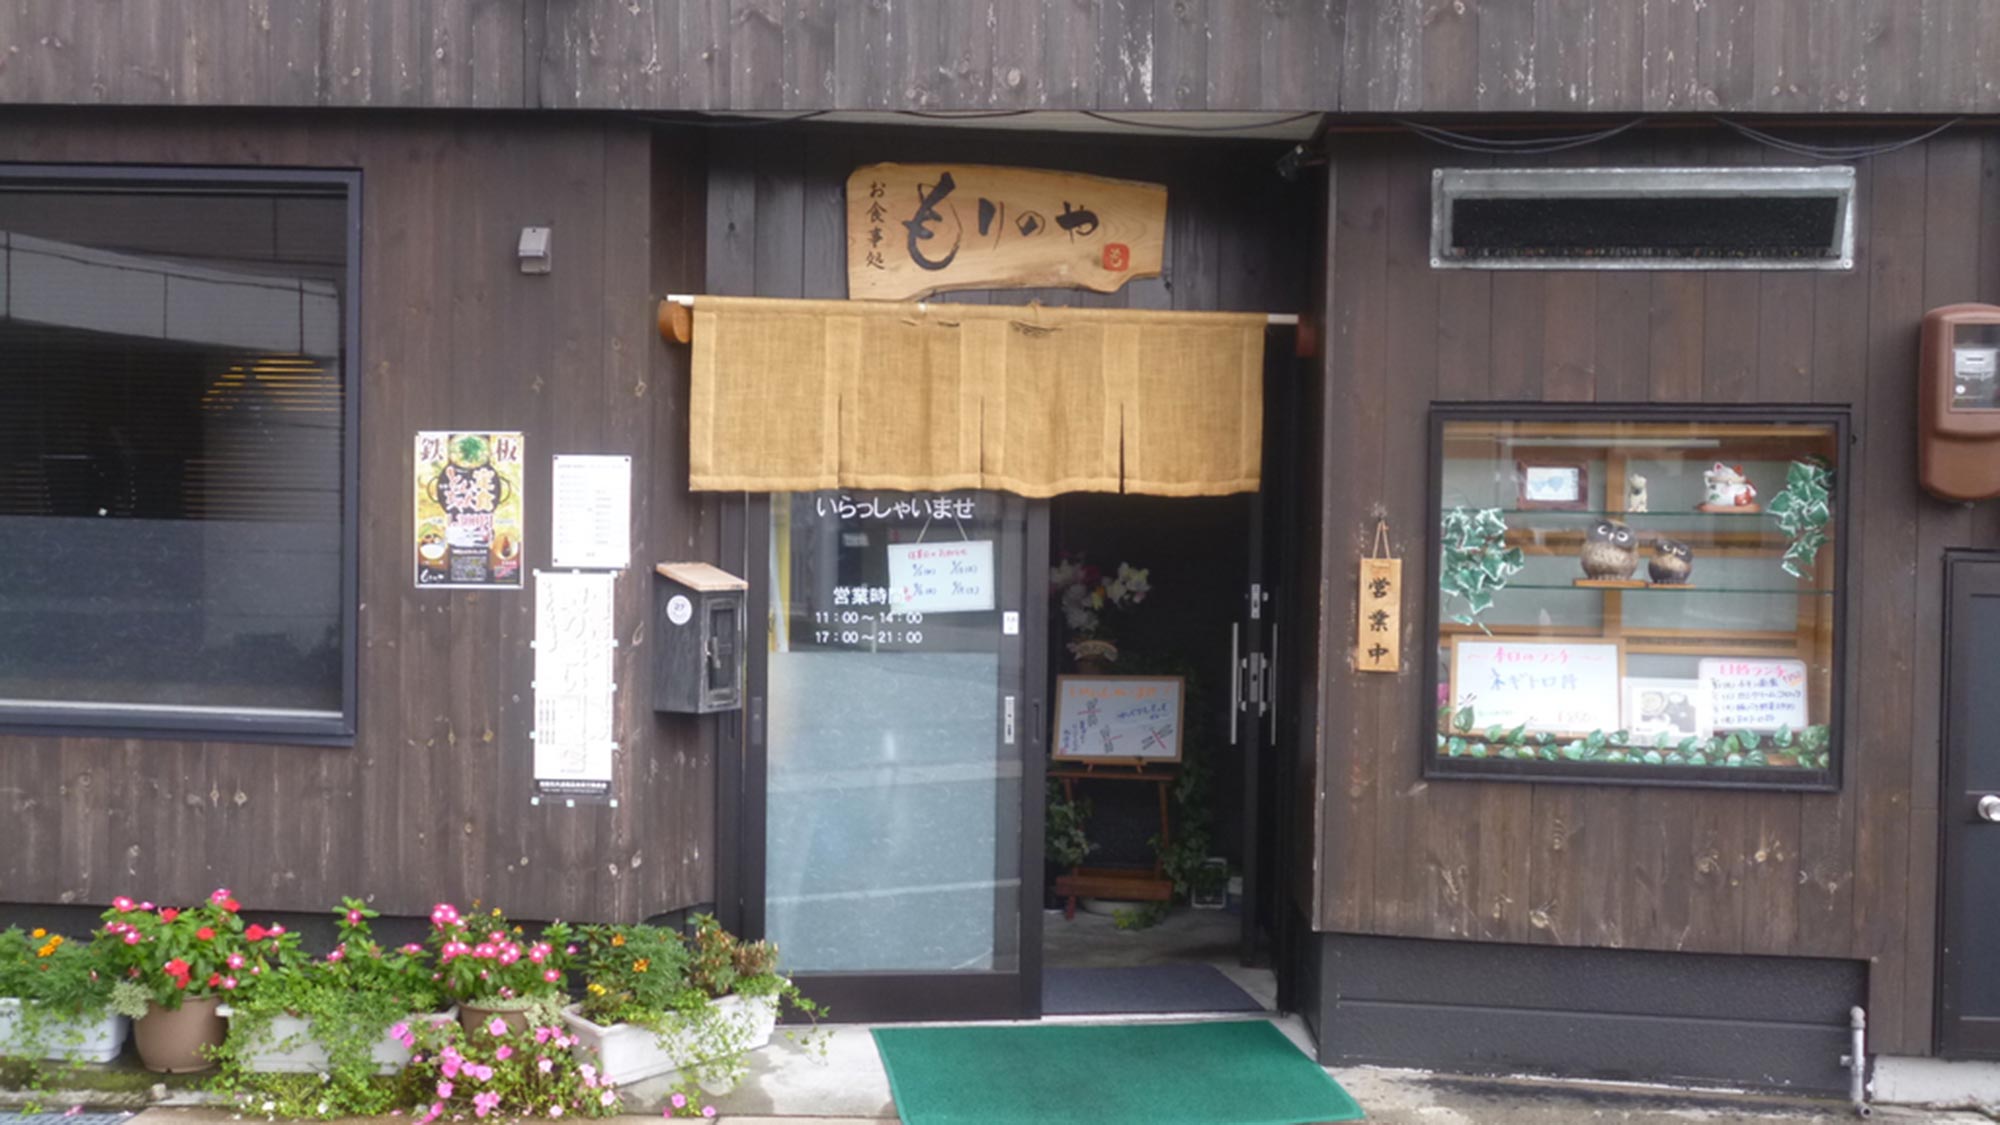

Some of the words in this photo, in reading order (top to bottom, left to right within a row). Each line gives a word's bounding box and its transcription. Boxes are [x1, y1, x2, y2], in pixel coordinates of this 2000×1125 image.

[866, 180, 888, 271] お食事処
[901, 171, 1100, 271] もりのや
[815, 494, 975, 519] いらっしゃいませ
[833, 586, 904, 605] 営業時
[1367, 576, 1391, 665] 営業中
